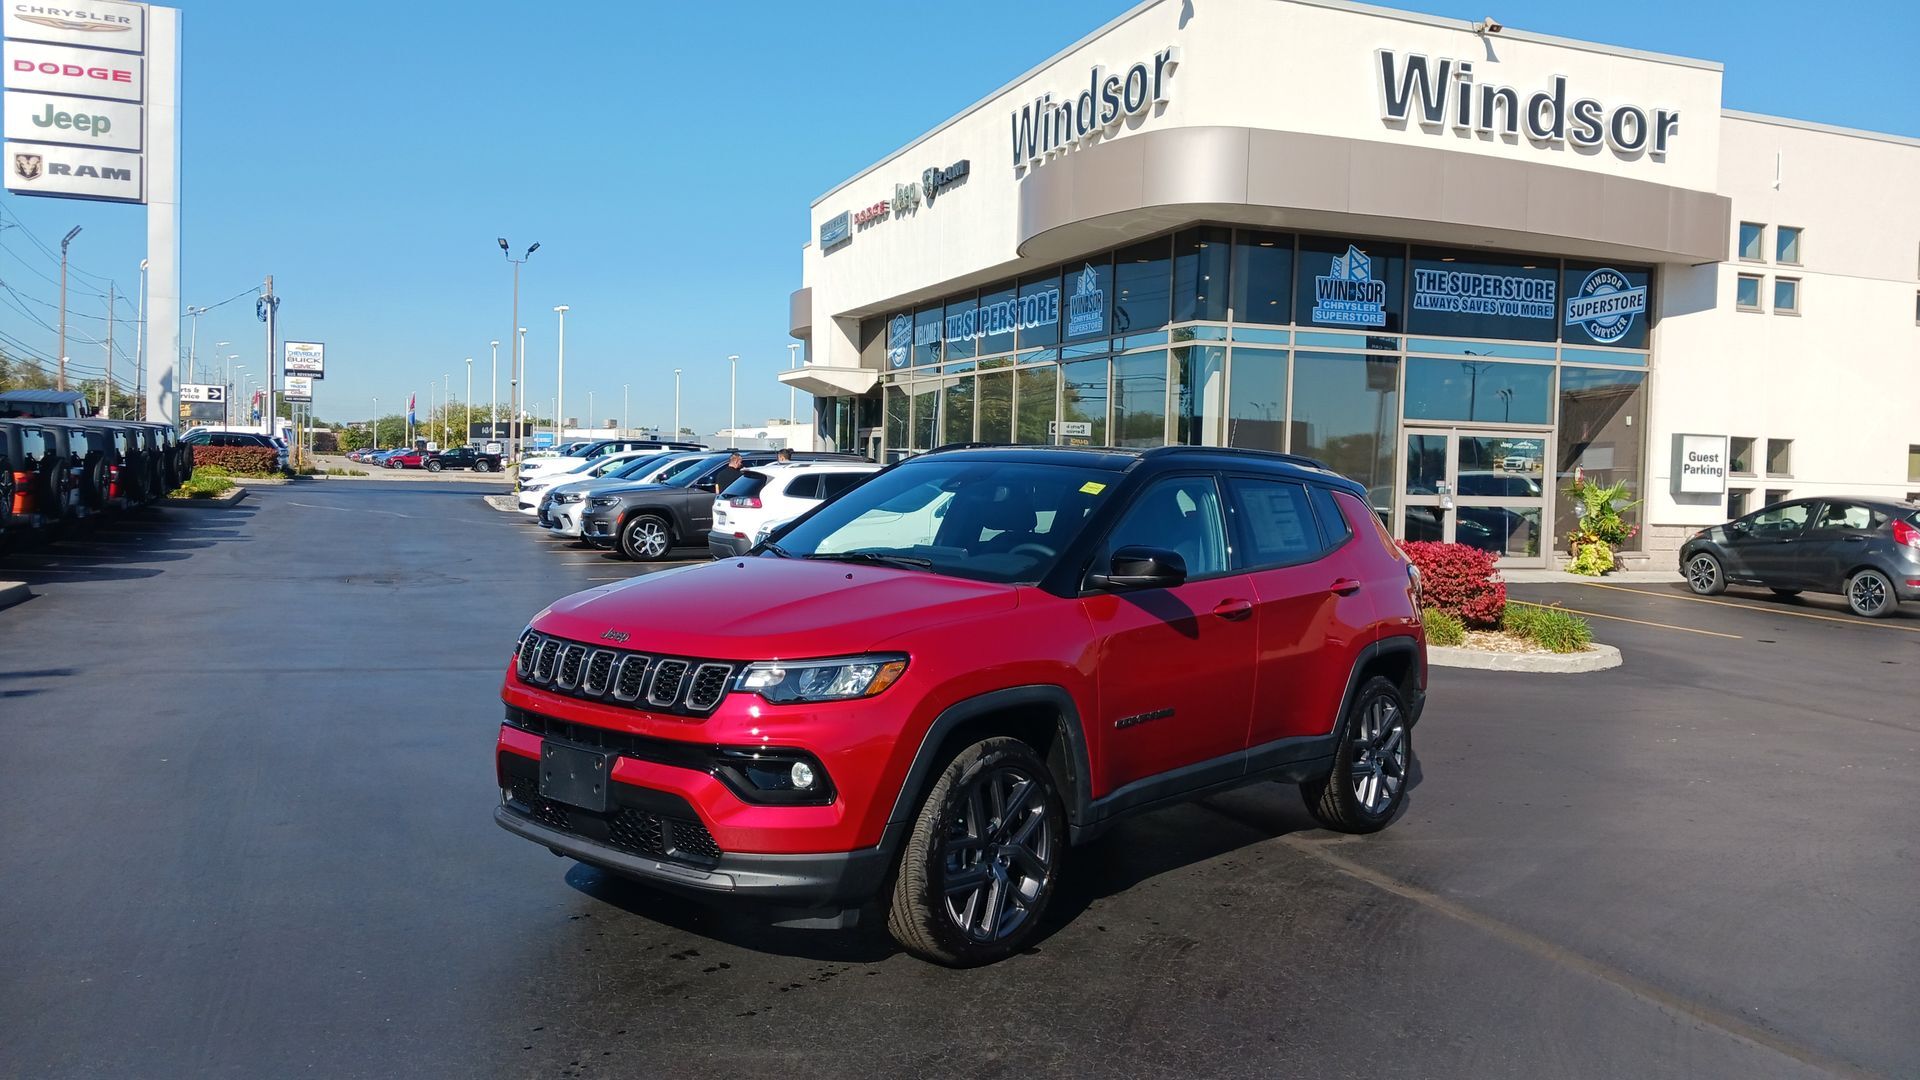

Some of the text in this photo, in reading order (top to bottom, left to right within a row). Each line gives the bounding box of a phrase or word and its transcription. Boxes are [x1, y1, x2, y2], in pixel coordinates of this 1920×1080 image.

[15, 4, 131, 24] CHRYSLER
[13, 59, 132, 83] DODGE
[1010, 46, 1178, 169] Windsor
[1376, 48, 1680, 154] Windsor
[31, 103, 112, 137] Jeep
[48, 162, 132, 182] RAM
[1318, 279, 1383, 303] WINDSOR
[1416, 271, 1555, 301] THE SUPERSTORE
[1585, 274, 1623, 293] WINDSOR
[946, 314, 962, 341] THE
[964, 289, 1058, 341] SUPERSTORE
[1323, 301, 1377, 312] CHRYSLER
[1415, 295, 1553, 317] ALWAYS SAVES YOU MORE!
[1569, 294, 1643, 319] SUPERSTORE
[1315, 311, 1384, 323] SUPERSTORE
[1590, 317, 1628, 338] CHRYSLER
[1688, 451, 1719, 462] Guest
[1683, 464, 1723, 477] Parking
[600, 626, 630, 643] Jeep
